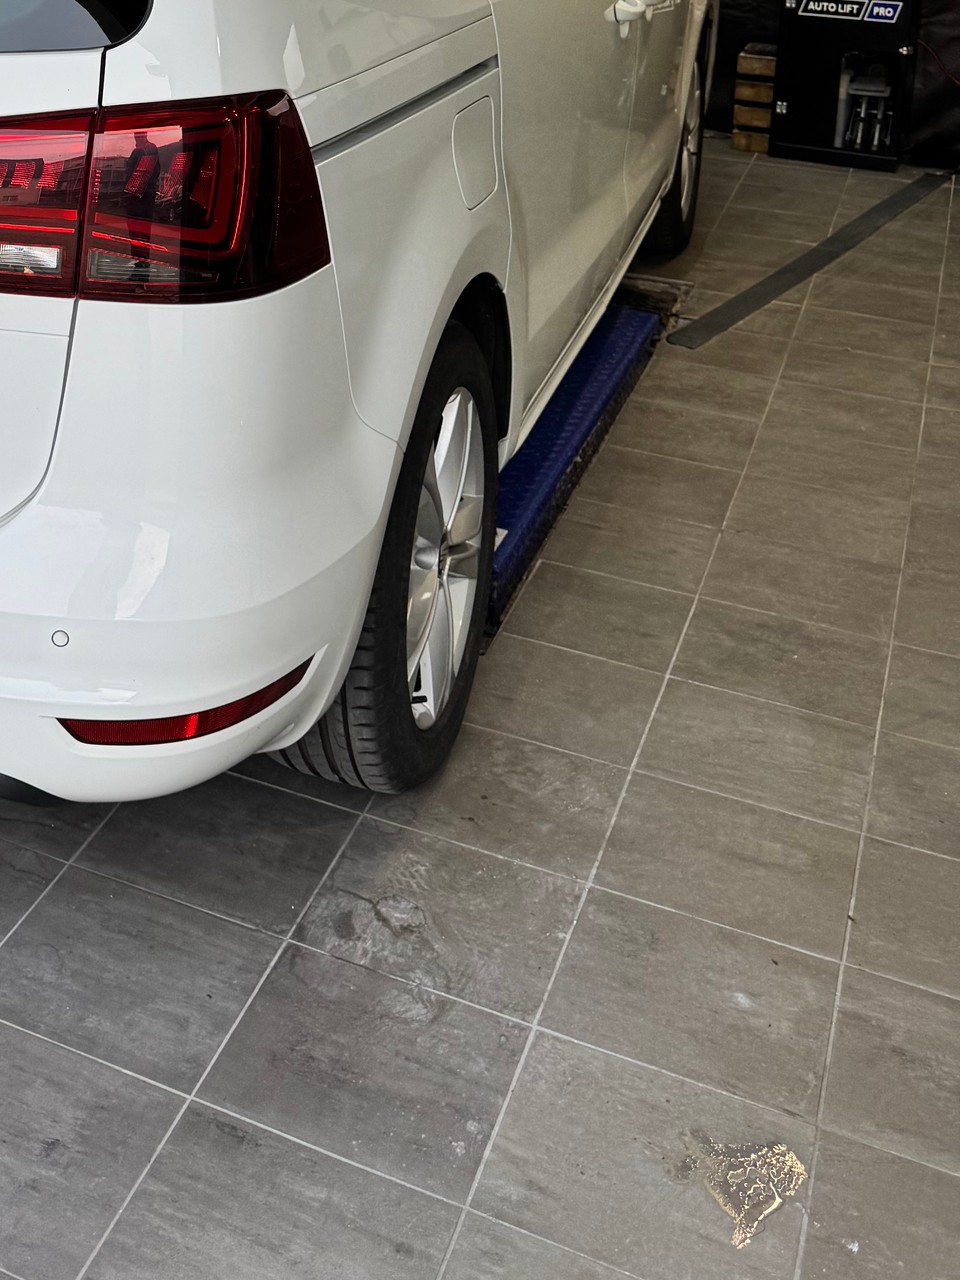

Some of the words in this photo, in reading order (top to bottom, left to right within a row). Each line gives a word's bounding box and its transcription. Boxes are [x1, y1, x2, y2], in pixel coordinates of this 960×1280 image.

[807, 1, 837, 12] AUTO
[838, 4, 859, 14] LIFT
[872, 6, 894, 17] PRO
